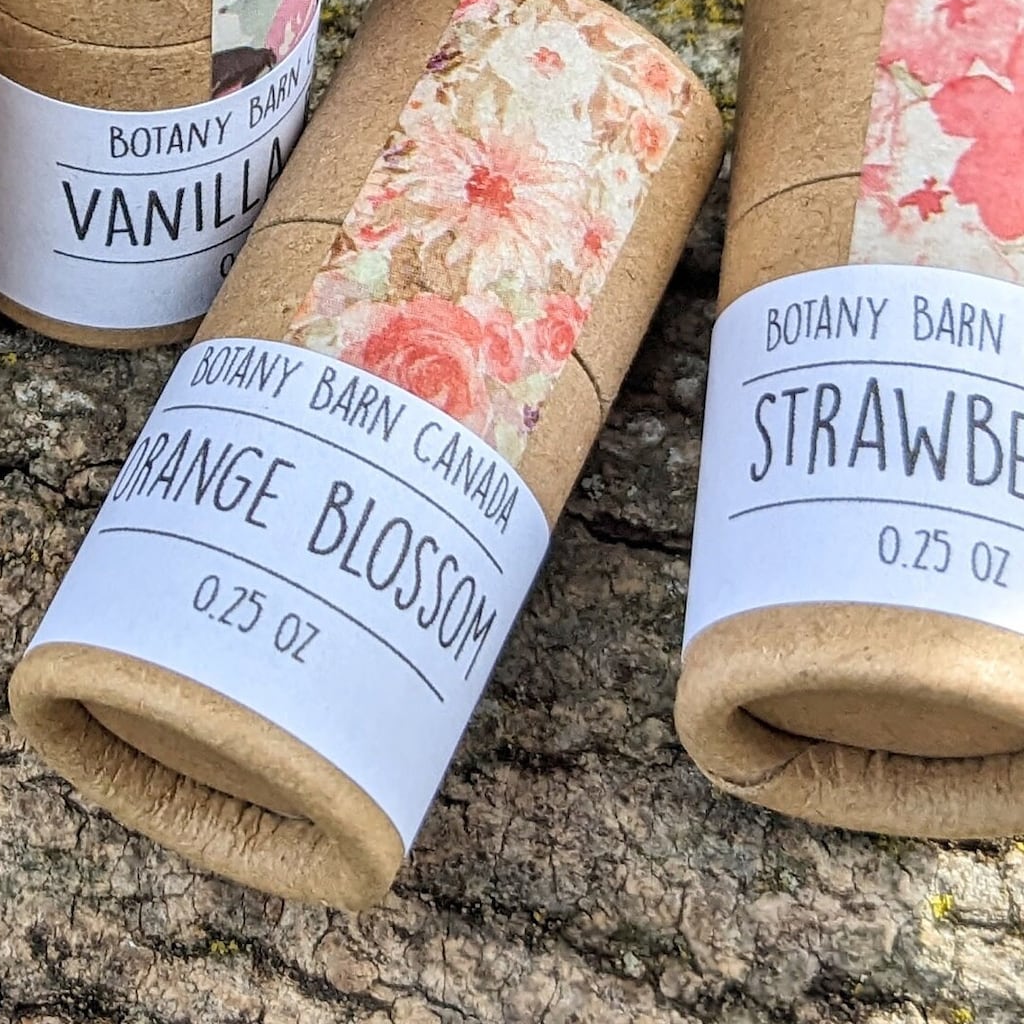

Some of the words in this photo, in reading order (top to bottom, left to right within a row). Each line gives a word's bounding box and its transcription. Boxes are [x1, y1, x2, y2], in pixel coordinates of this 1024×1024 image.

[109, 111, 232, 158] BOTANY
[249, 58, 301, 128] BARN
[61, 136, 284, 247] VANILLA
[767, 294, 888, 352] BOTANY
[914, 295, 1005, 355] BARN
[190, 346, 303, 398] BOTANY
[310, 365, 406, 443] BARN
[413, 421, 521, 534] CANADA
[113, 428, 296, 529] ORANGE
[308, 480, 498, 681] BLOSSOM
[878, 525, 951, 574] 0.25
[971, 541, 1011, 588] OZ
[192, 574, 267, 633] 0.25
[274, 613, 320, 663] OZ
